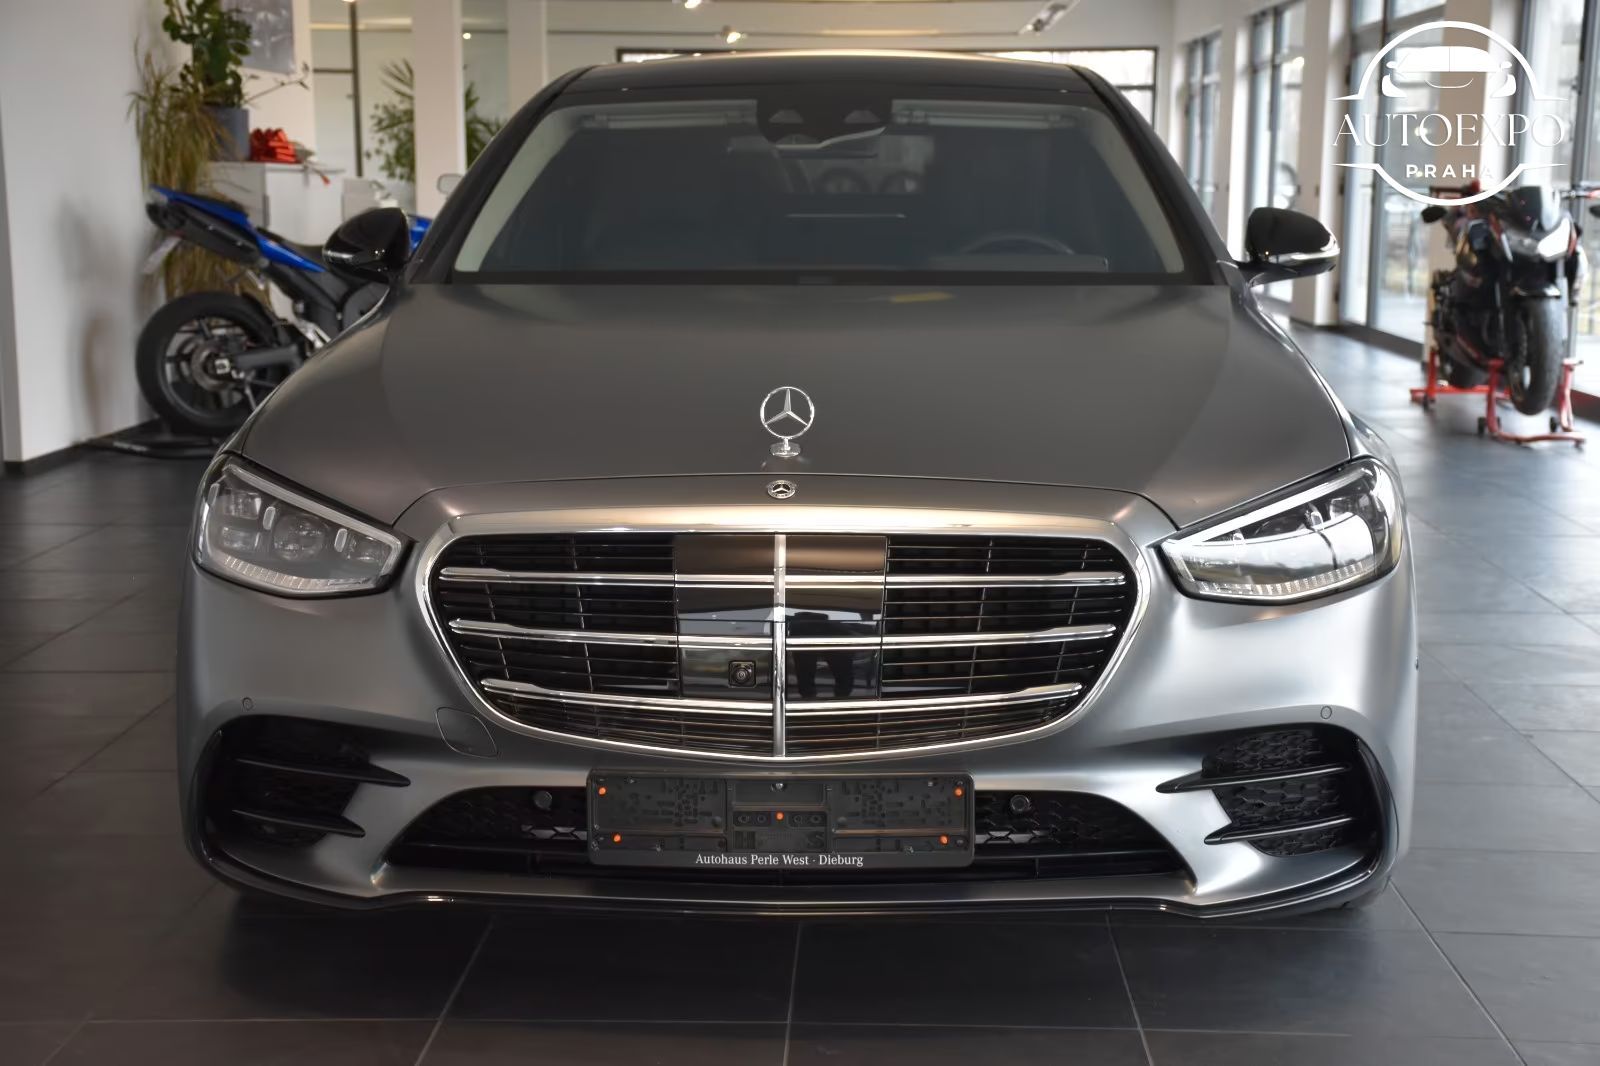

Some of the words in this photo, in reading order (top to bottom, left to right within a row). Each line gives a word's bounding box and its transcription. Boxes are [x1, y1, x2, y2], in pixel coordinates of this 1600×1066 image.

[695, 853, 748, 865] Autohaus
[750, 854, 780, 865] Perle
[782, 854, 809, 866] West
[818, 854, 864, 868] Dieburg
